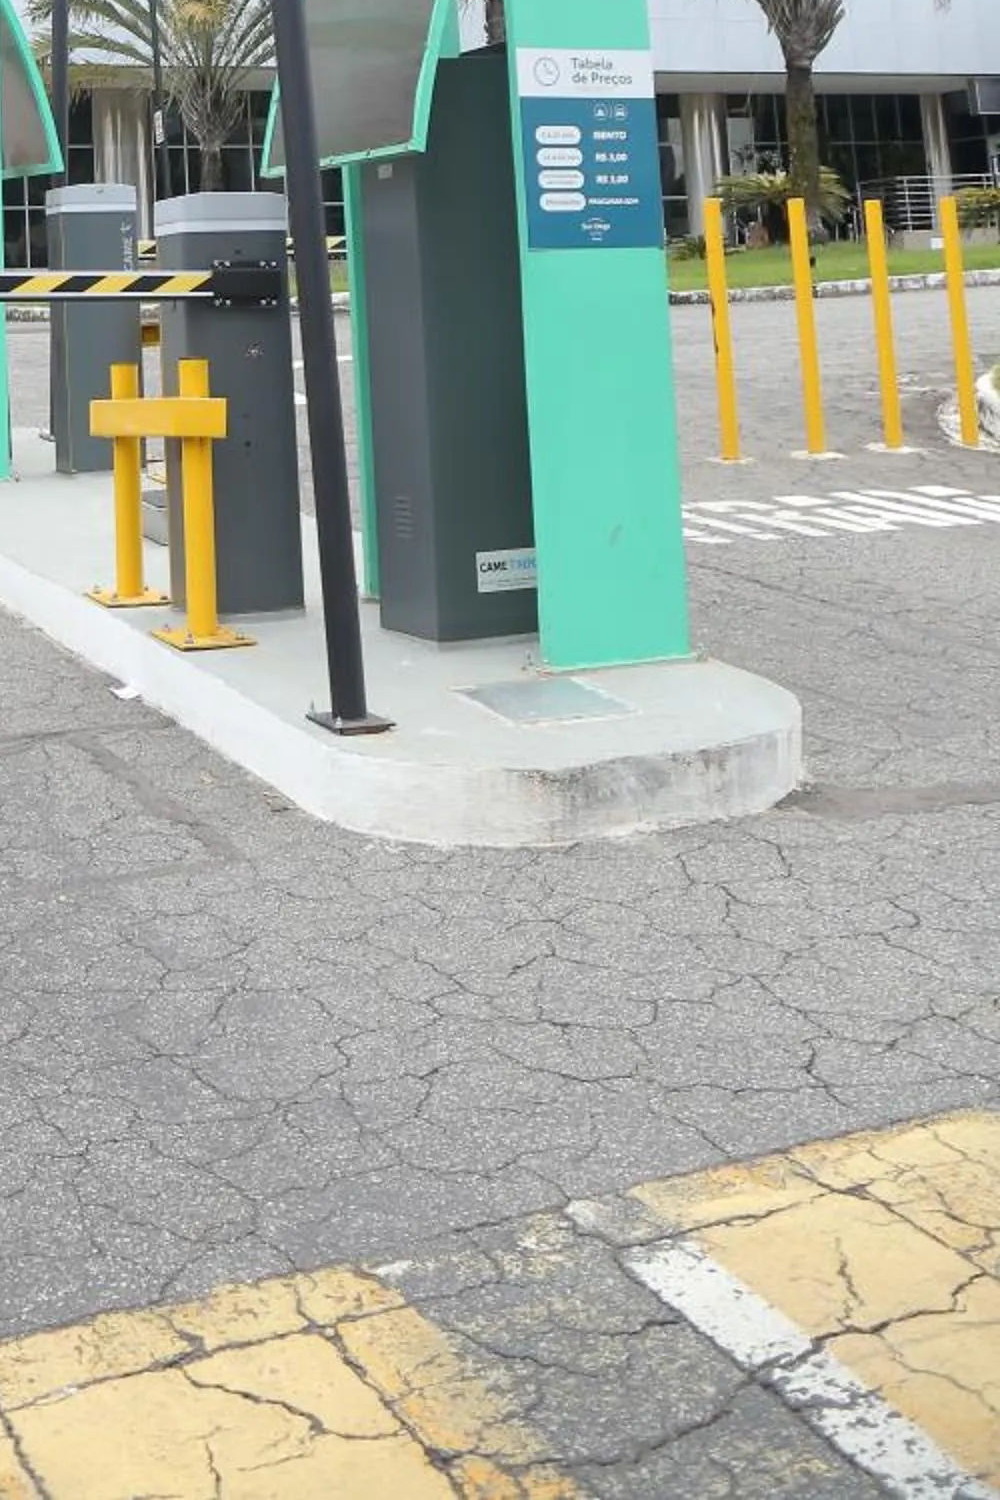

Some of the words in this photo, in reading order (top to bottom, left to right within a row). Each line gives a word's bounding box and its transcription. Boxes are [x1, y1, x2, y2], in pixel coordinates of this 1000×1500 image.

[570, 56, 612, 70] Tabela
[572, 72, 588, 84] de
[480, 560, 508, 573] CAME
